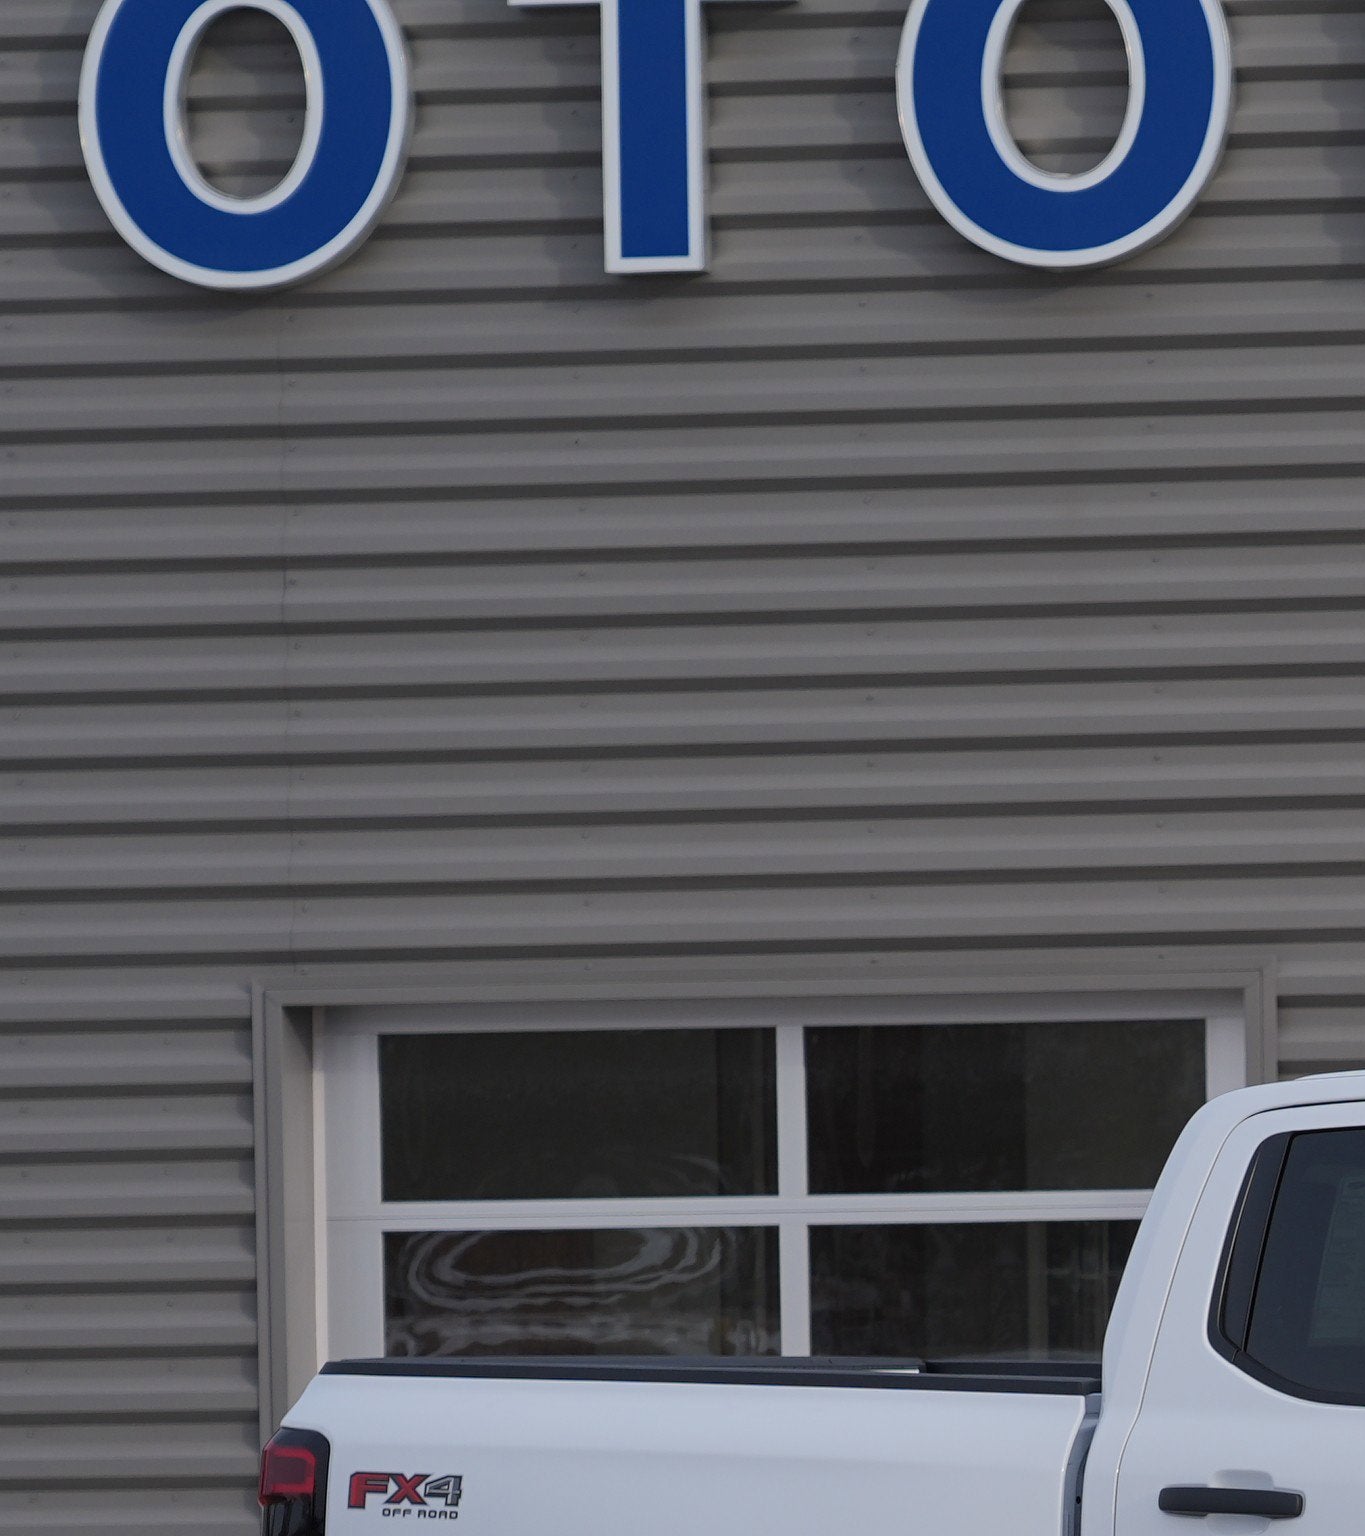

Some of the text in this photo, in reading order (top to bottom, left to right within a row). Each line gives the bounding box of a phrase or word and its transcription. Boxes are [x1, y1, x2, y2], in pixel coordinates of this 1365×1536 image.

[347, 1470, 463, 1510] FX4
[382, 1507, 459, 1520] OFF ROAD
